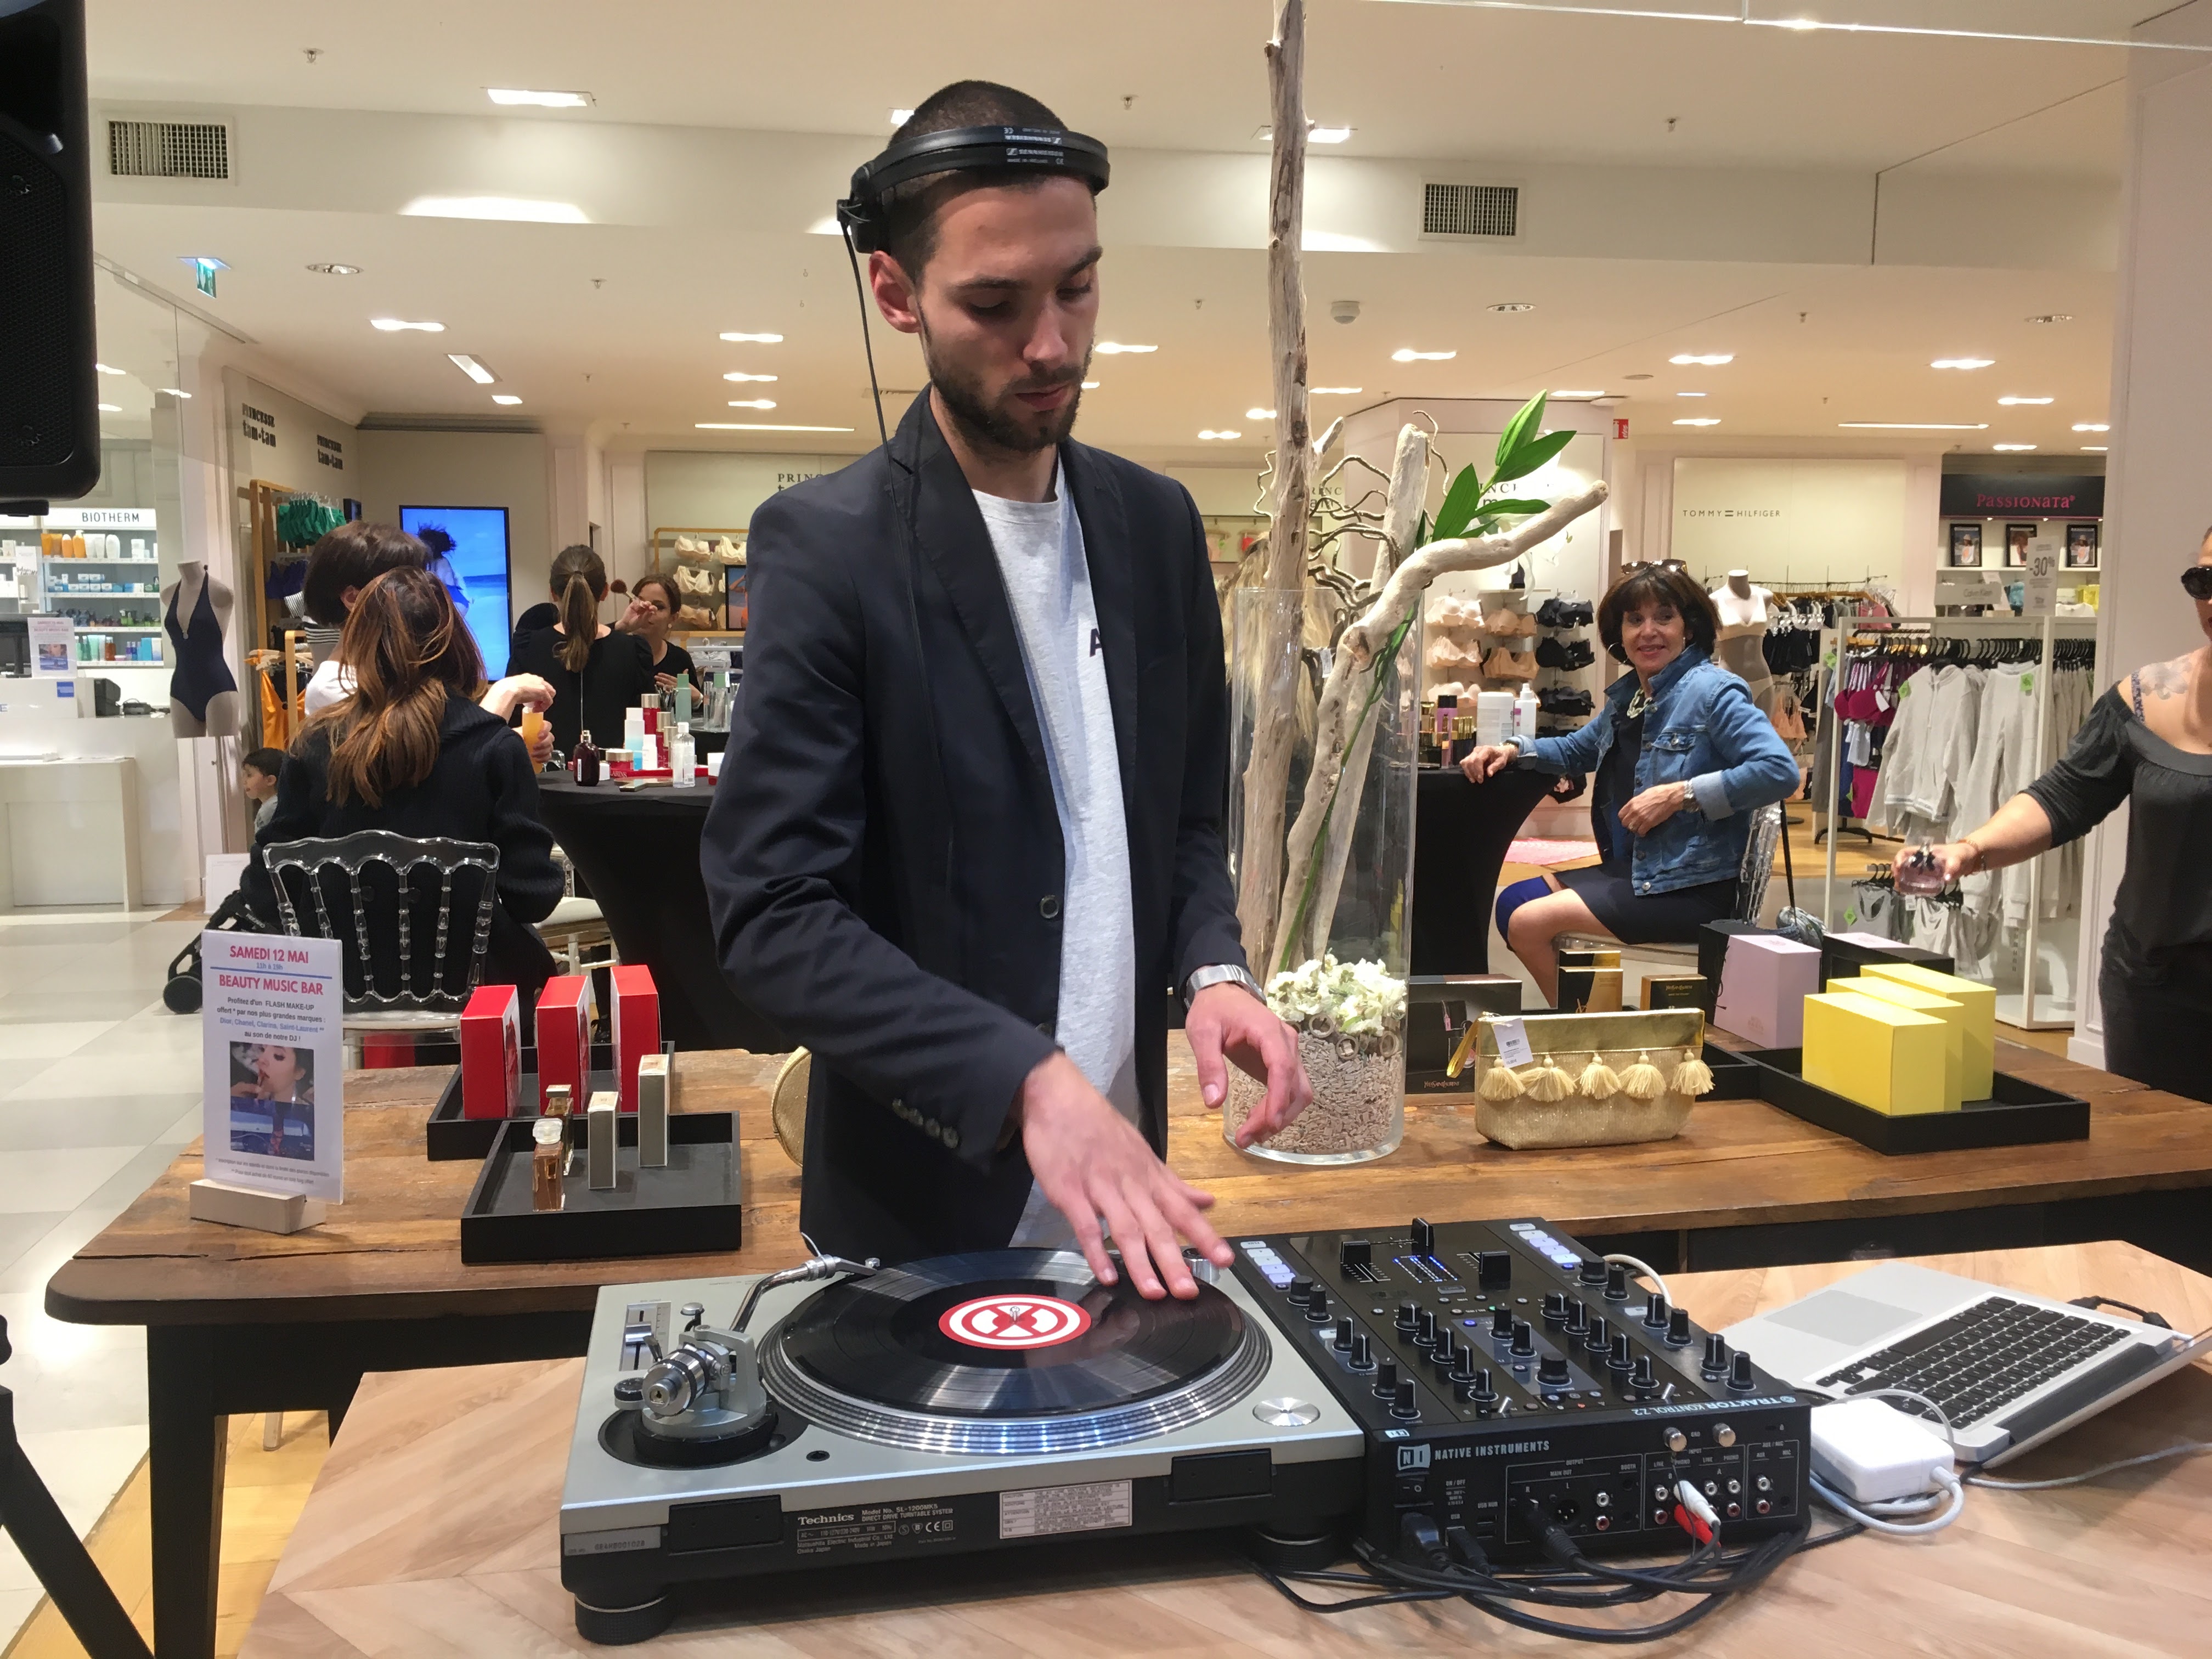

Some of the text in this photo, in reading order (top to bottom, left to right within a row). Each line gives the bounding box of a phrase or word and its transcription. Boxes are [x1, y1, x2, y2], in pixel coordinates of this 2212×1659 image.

[82, 512, 139, 522] BIOTHERM
[230, 945, 308, 963] SAMEDI 12 MAI
[219, 974, 324, 995] BEAUTY MUSIC BAR
[228, 997, 249, 1005] Profitez
[273, 1012, 296, 1020] grandes
[1631, 1397, 1782, 1416] TRAKTOR KONTROL Z2
[1435, 1447, 1471, 1460] NATIVE
[1476, 1441, 1549, 1457] INSTRUMENTS
[798, 1514, 854, 1525] Technics
[900, 1510, 930, 1519] TURNTABLE
